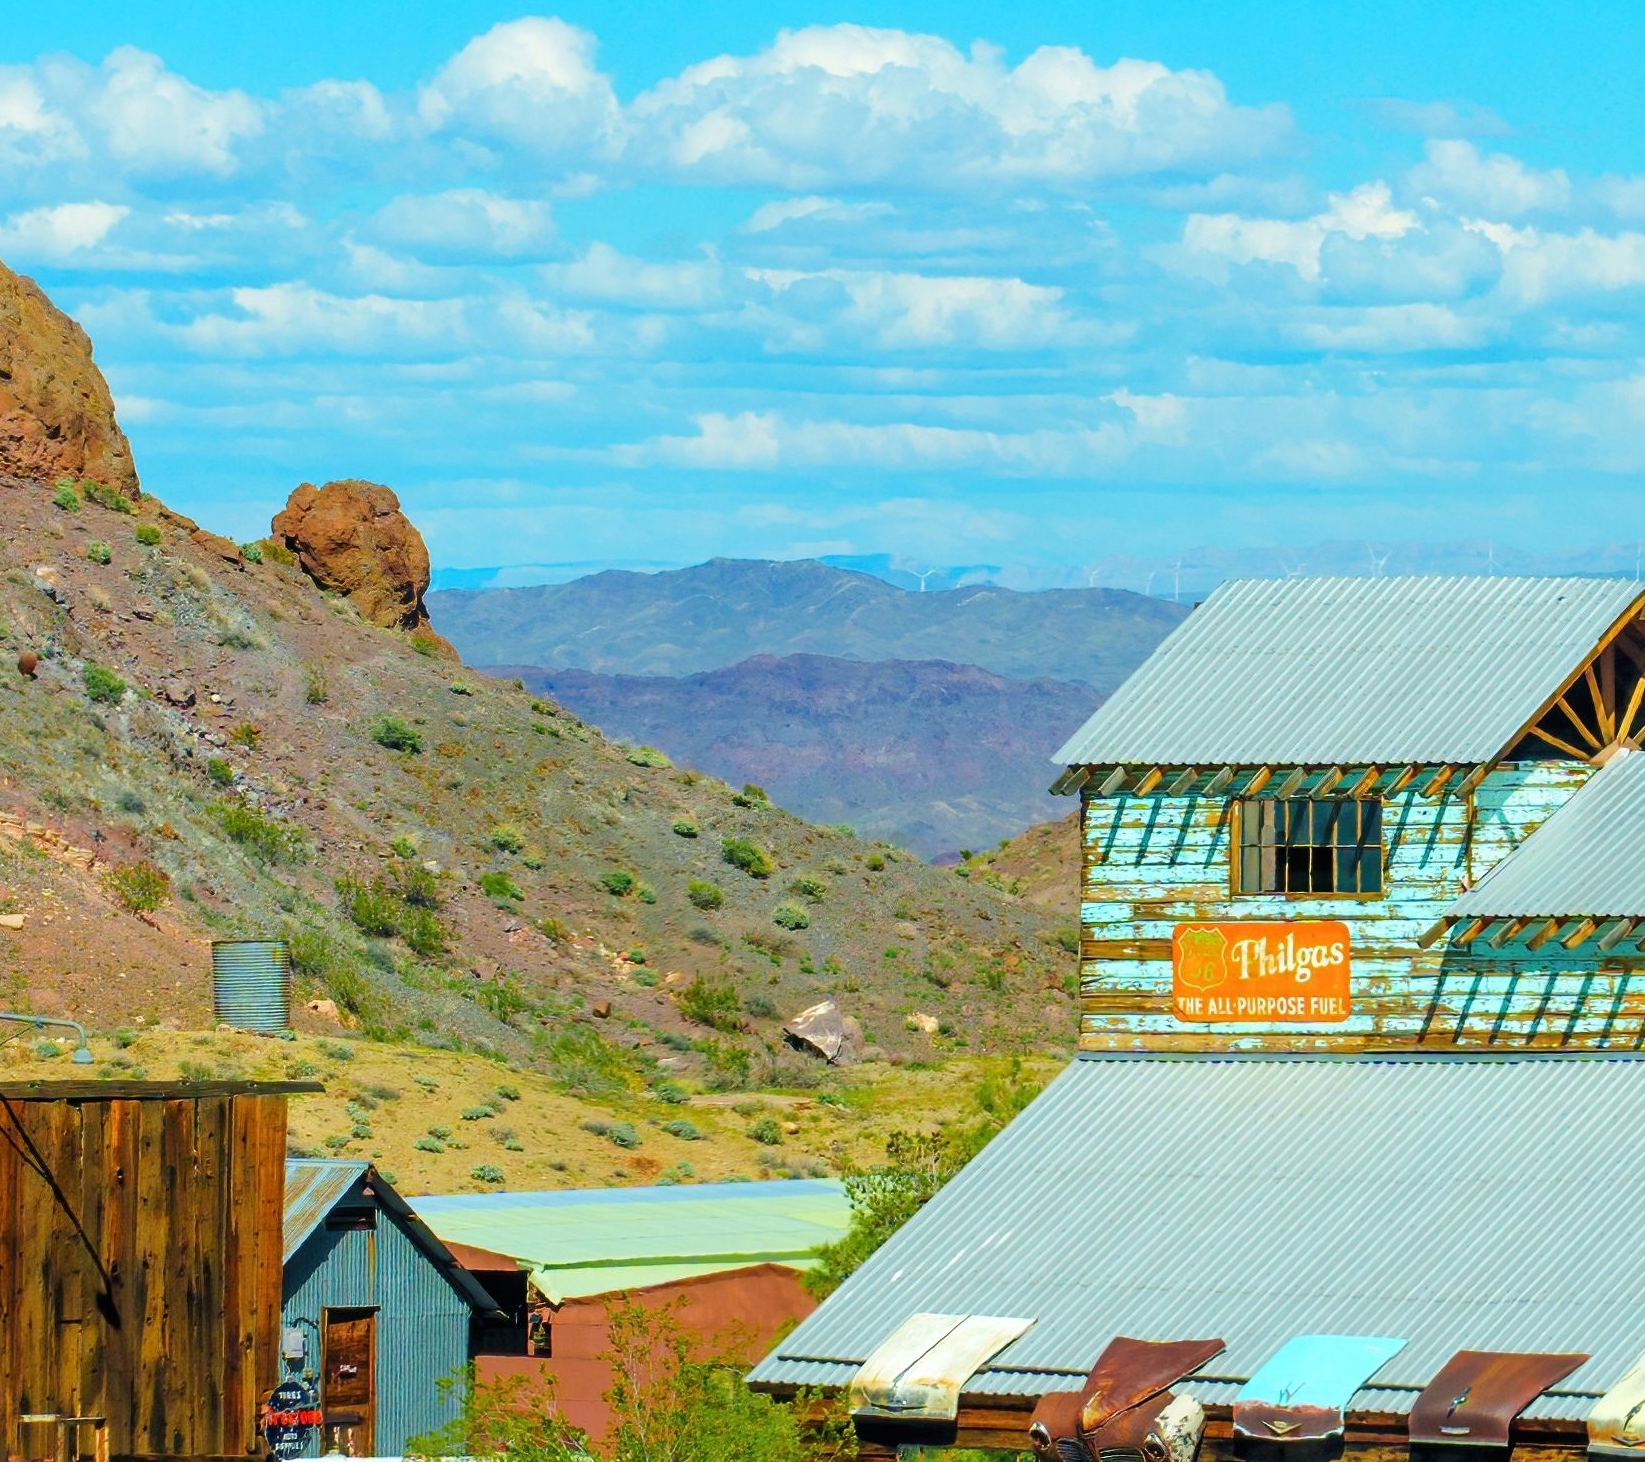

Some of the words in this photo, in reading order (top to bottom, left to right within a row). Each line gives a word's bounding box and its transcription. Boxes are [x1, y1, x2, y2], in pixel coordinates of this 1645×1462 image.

[1231, 932, 1344, 983] Philgas
[1177, 997, 1204, 1015] THE
[1310, 997, 1347, 1015] FUEL
